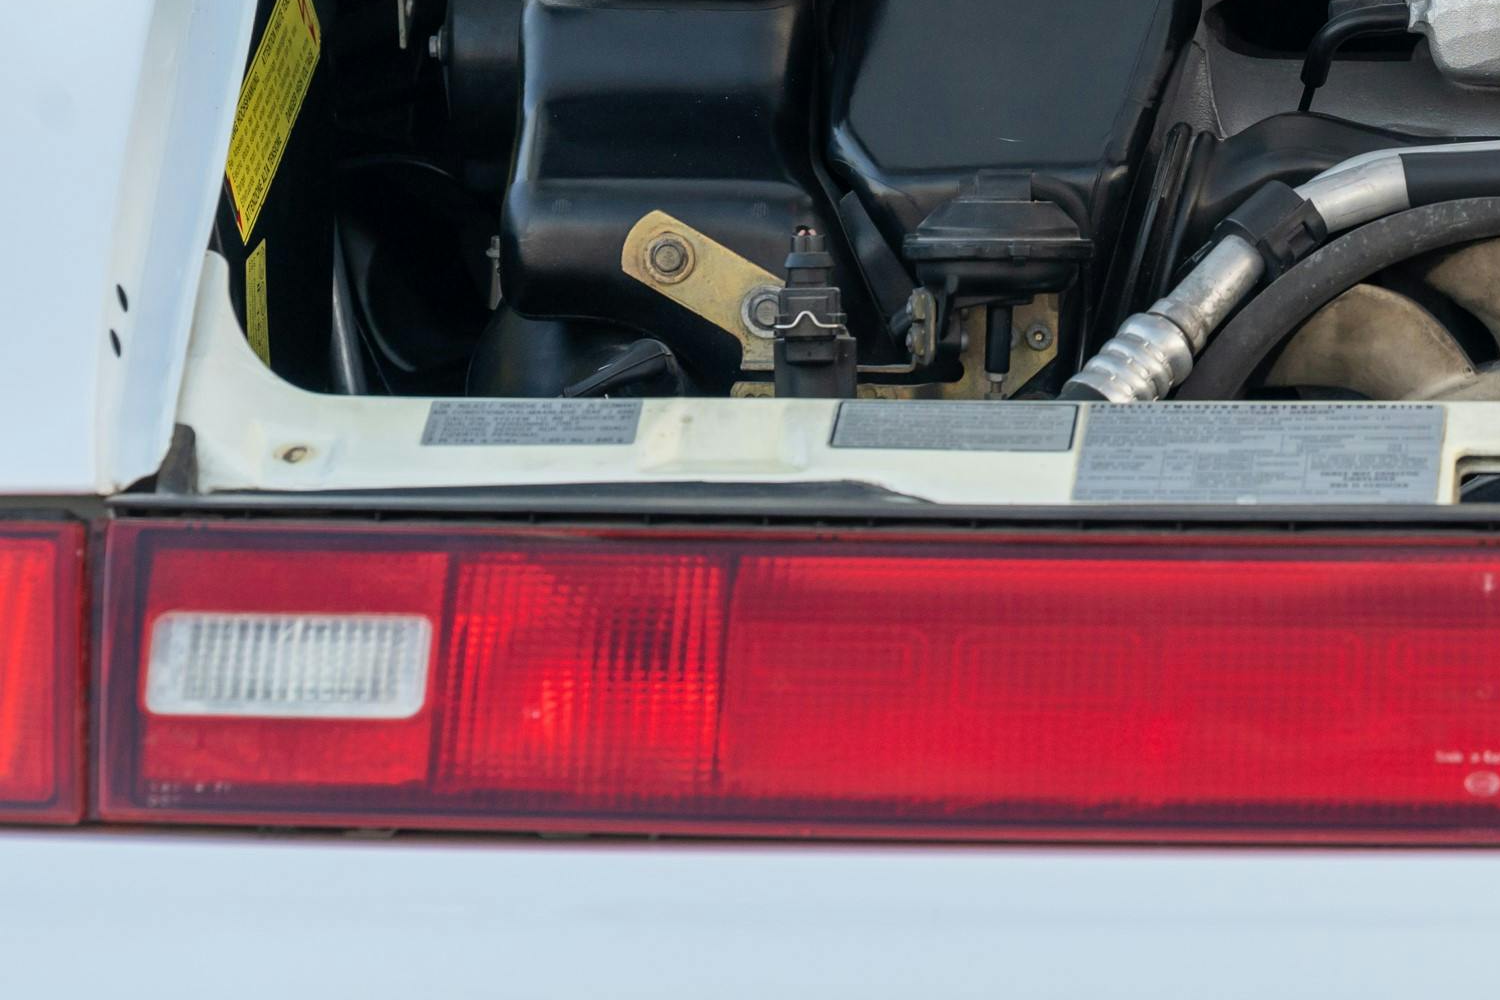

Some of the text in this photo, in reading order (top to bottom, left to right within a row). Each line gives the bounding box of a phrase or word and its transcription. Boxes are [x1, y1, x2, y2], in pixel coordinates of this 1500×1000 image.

[261, 26, 276, 67] ATTENTION
[273, 6, 283, 35] HAUTE
[244, 176, 262, 225] ATTENZIONE
[260, 159, 270, 186] ALTA
[267, 129, 281, 169] TENSIONE
